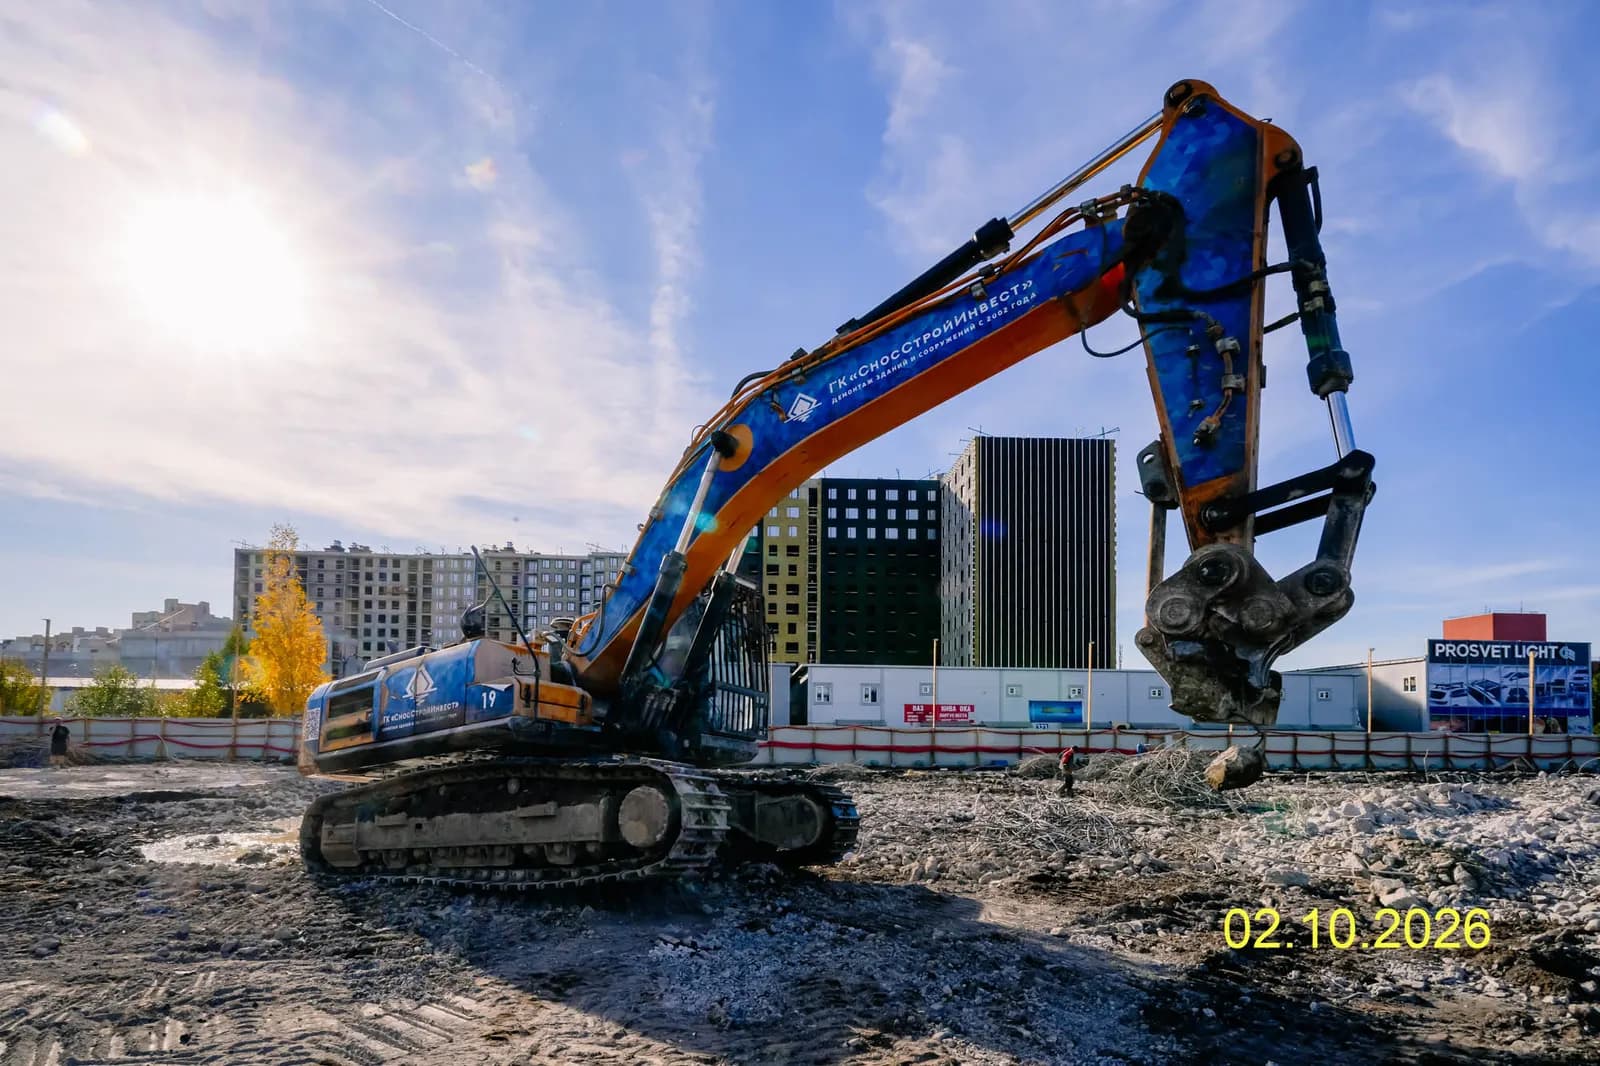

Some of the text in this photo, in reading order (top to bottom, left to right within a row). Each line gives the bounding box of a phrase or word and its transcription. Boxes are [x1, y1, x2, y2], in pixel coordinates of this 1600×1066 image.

[831, 379, 874, 405] ДЕМОНТАЖ
[875, 358, 909, 381] ЗДАНИЙ
[910, 354, 917, 363] И
[918, 323, 976, 358] СООРУЖЕНИЙ
[987, 306, 1009, 323] 2002
[1011, 292, 1037, 310] ГОДА
[828, 375, 848, 394] ГК
[1435, 643, 1558, 659] PROSVET LIGHT
[481, 690, 497, 710] 19
